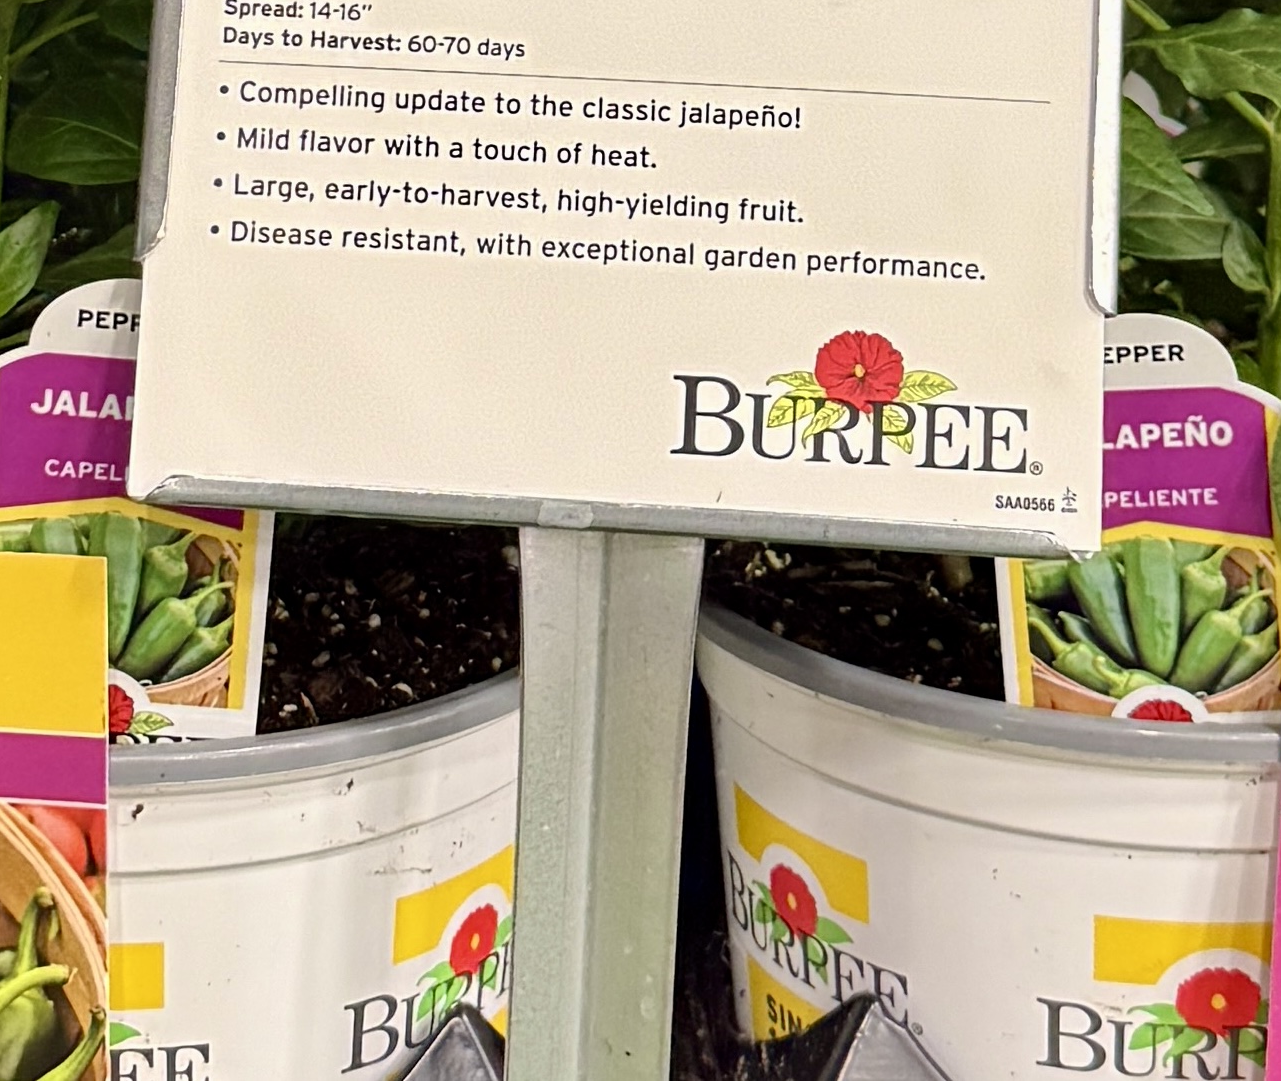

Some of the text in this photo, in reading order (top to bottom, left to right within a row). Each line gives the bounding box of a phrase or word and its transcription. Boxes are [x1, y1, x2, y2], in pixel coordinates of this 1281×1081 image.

[222, 26, 526, 61] Days to Harvest: 60-70 days
[239, 80, 802, 130] Compelling update to the classic jalapeño!
[236, 127, 658, 170] Mild flavor with a touch of heat.
[233, 172, 804, 225] Large, early-to-harvest, high-yielding fruit.
[230, 220, 987, 281] Disease resistant, with exceptional garden performance.
[1104, 344, 1185, 364] EPPER
[30, 387, 135, 422] JALA
[1104, 487, 1219, 509] PELIENTE
[1035, 996, 1268, 1081] BURP
